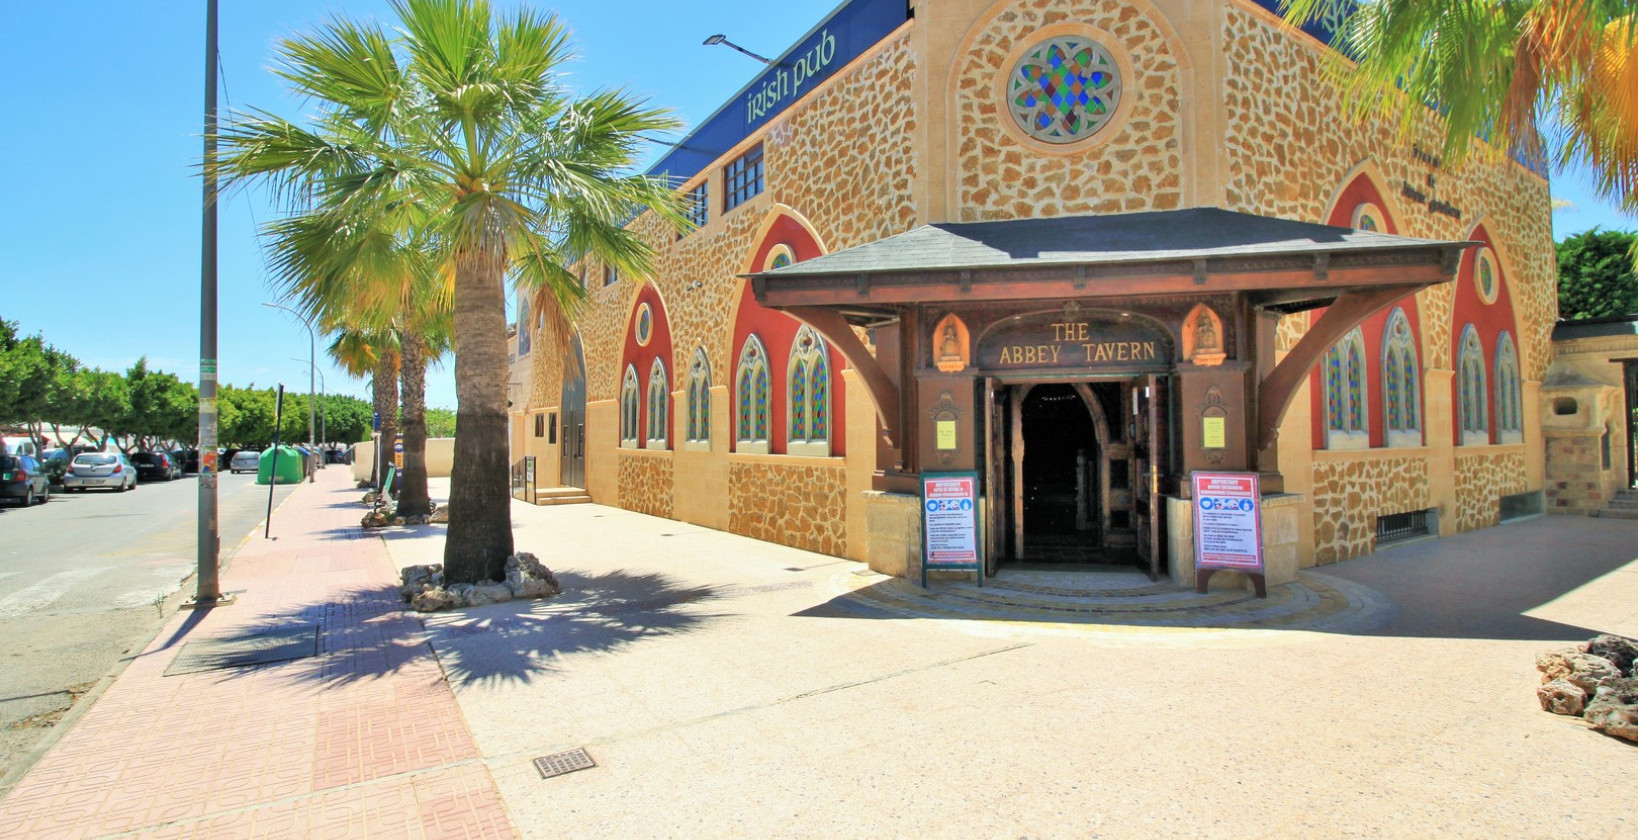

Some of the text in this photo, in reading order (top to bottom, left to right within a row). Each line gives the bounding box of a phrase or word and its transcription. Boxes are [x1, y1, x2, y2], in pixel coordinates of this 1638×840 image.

[793, 28, 836, 98] pub
[1051, 322, 1090, 342] THE
[999, 341, 1156, 365] ABBEY TAVERN
